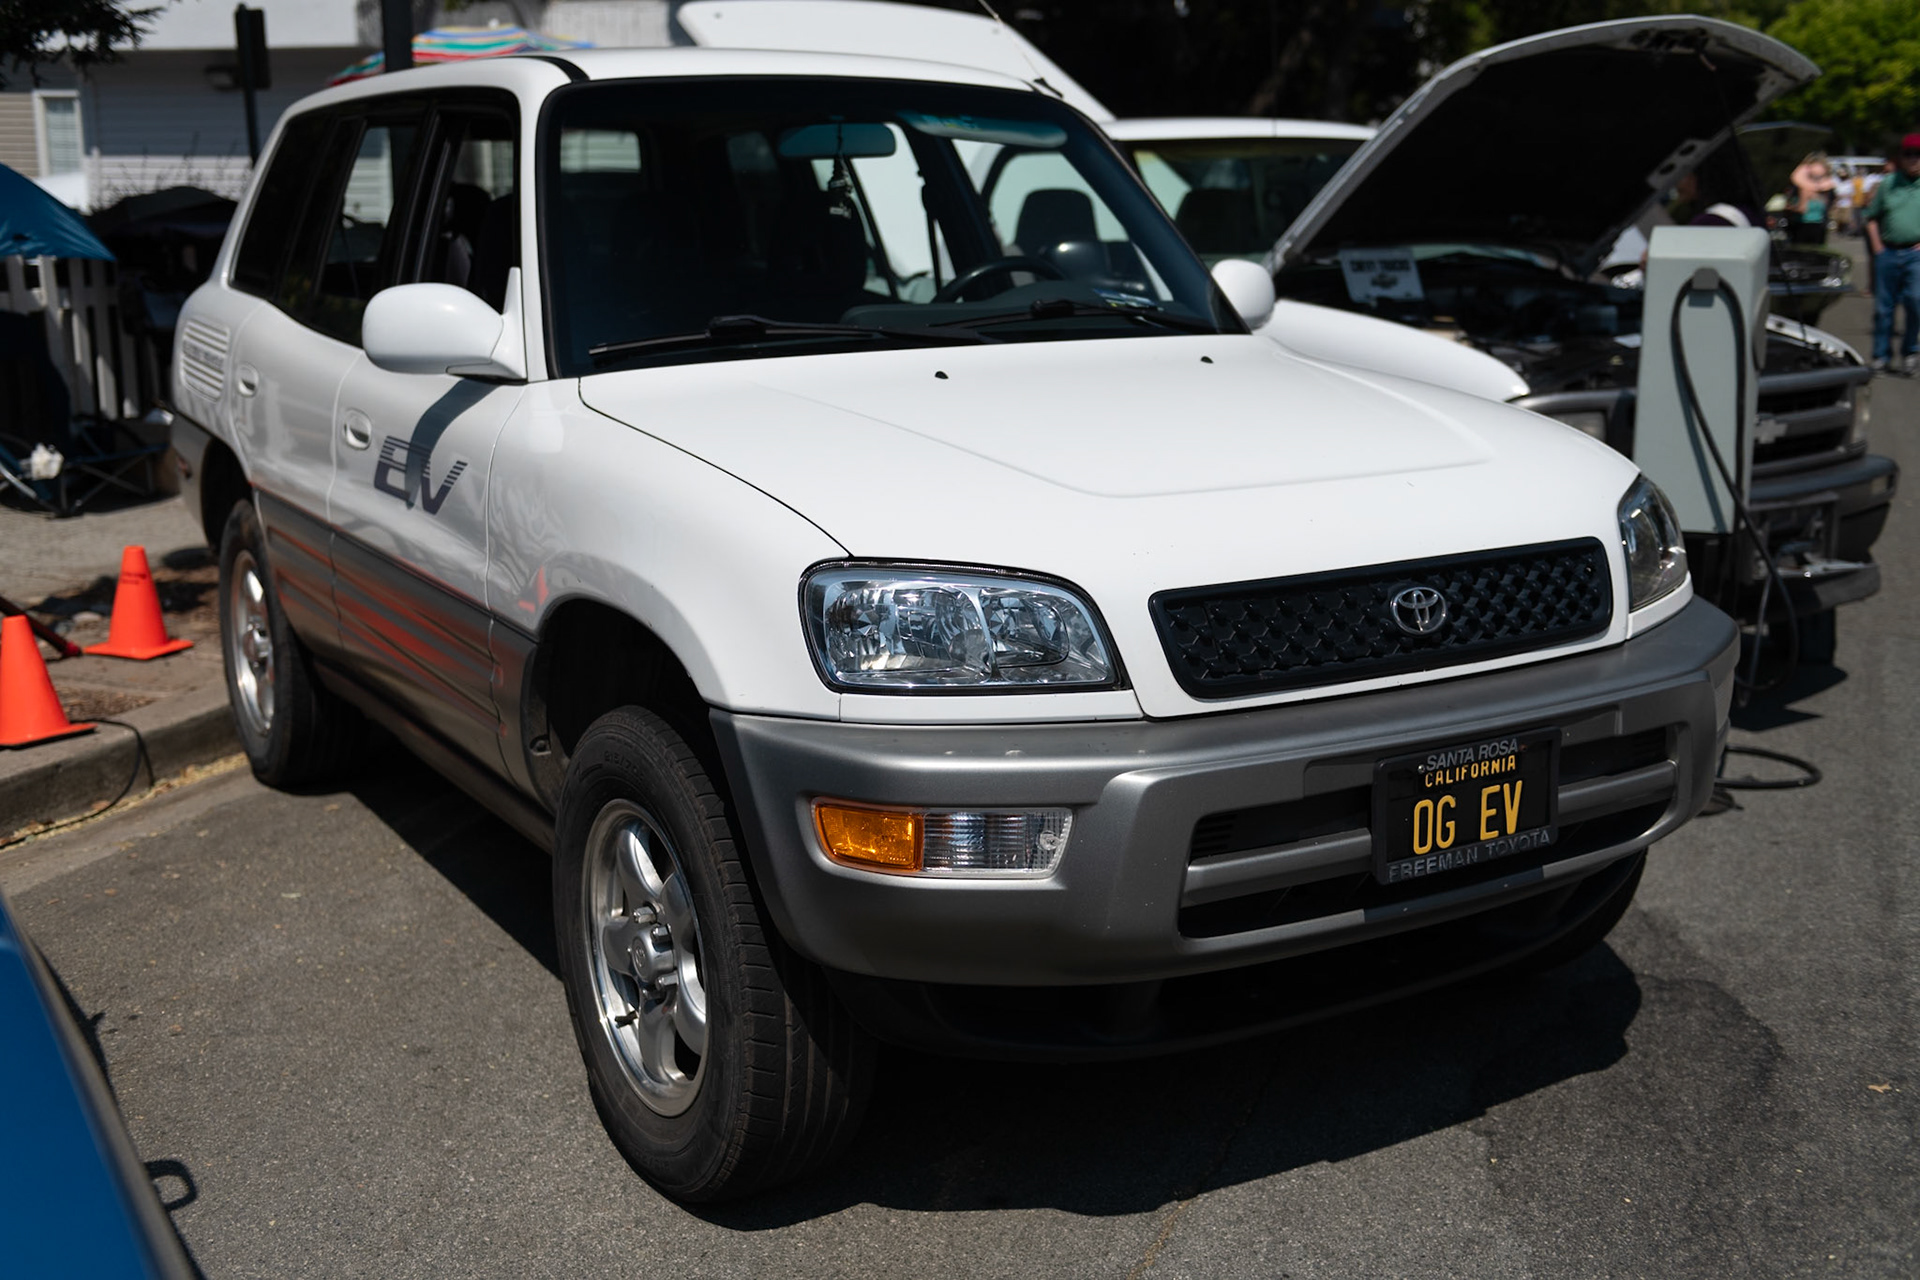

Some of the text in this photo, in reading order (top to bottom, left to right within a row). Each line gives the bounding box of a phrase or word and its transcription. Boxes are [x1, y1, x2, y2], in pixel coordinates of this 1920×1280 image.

[374, 435, 468, 515] EV
[1425, 755, 1516, 788] CALIFORNIA
[1426, 738, 1519, 771] SANTA ROSA
[1413, 780, 1523, 855] OG EV
[1389, 830, 1550, 883] FREEMAN TOYOTA
